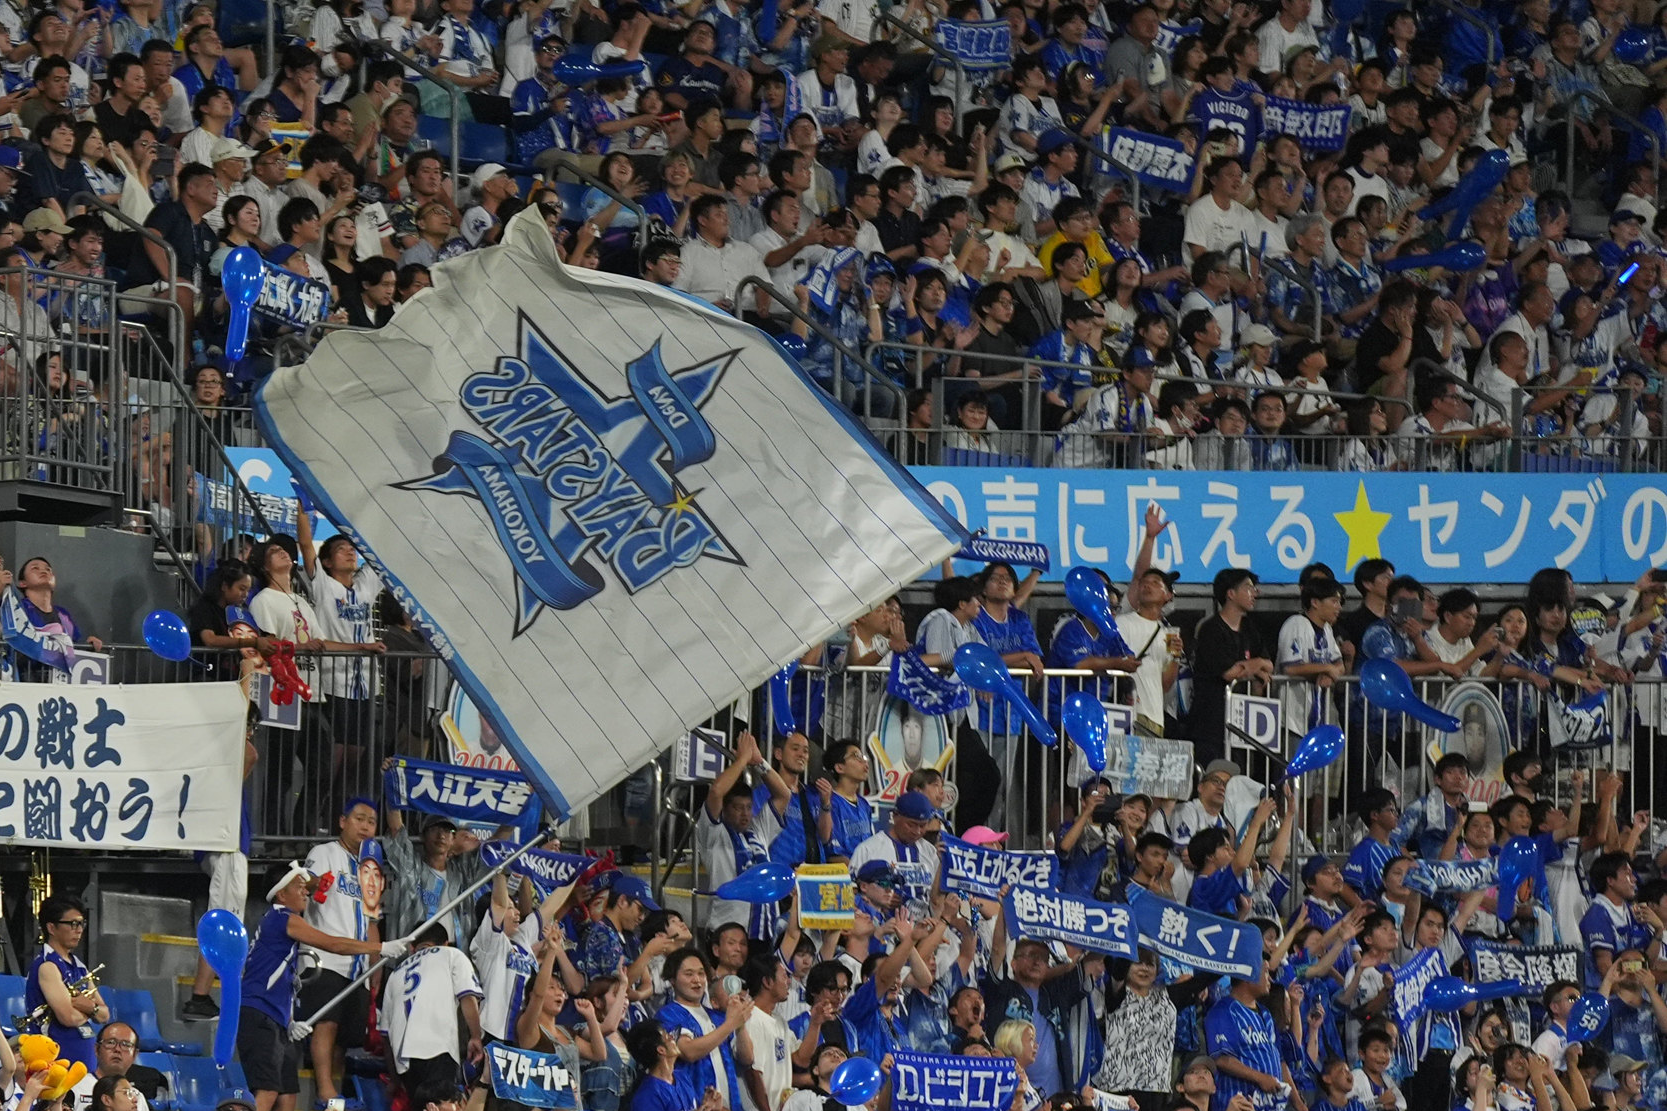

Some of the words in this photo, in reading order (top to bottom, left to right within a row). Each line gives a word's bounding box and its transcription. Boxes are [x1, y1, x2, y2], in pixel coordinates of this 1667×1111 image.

[971, 538, 1047, 565] YOKOHAMA
[1248, 703, 1276, 740] D
[696, 735, 717, 778] E
[410, 767, 532, 816] 入江大生
[948, 846, 1052, 889] 立ち上がるとき
[1013, 887, 1131, 940] 絶対勝つぞ
[404, 963, 422, 995] 5
[1578, 1013, 1599, 1032] 58
[896, 1063, 1017, 1108] D.ビシエド
